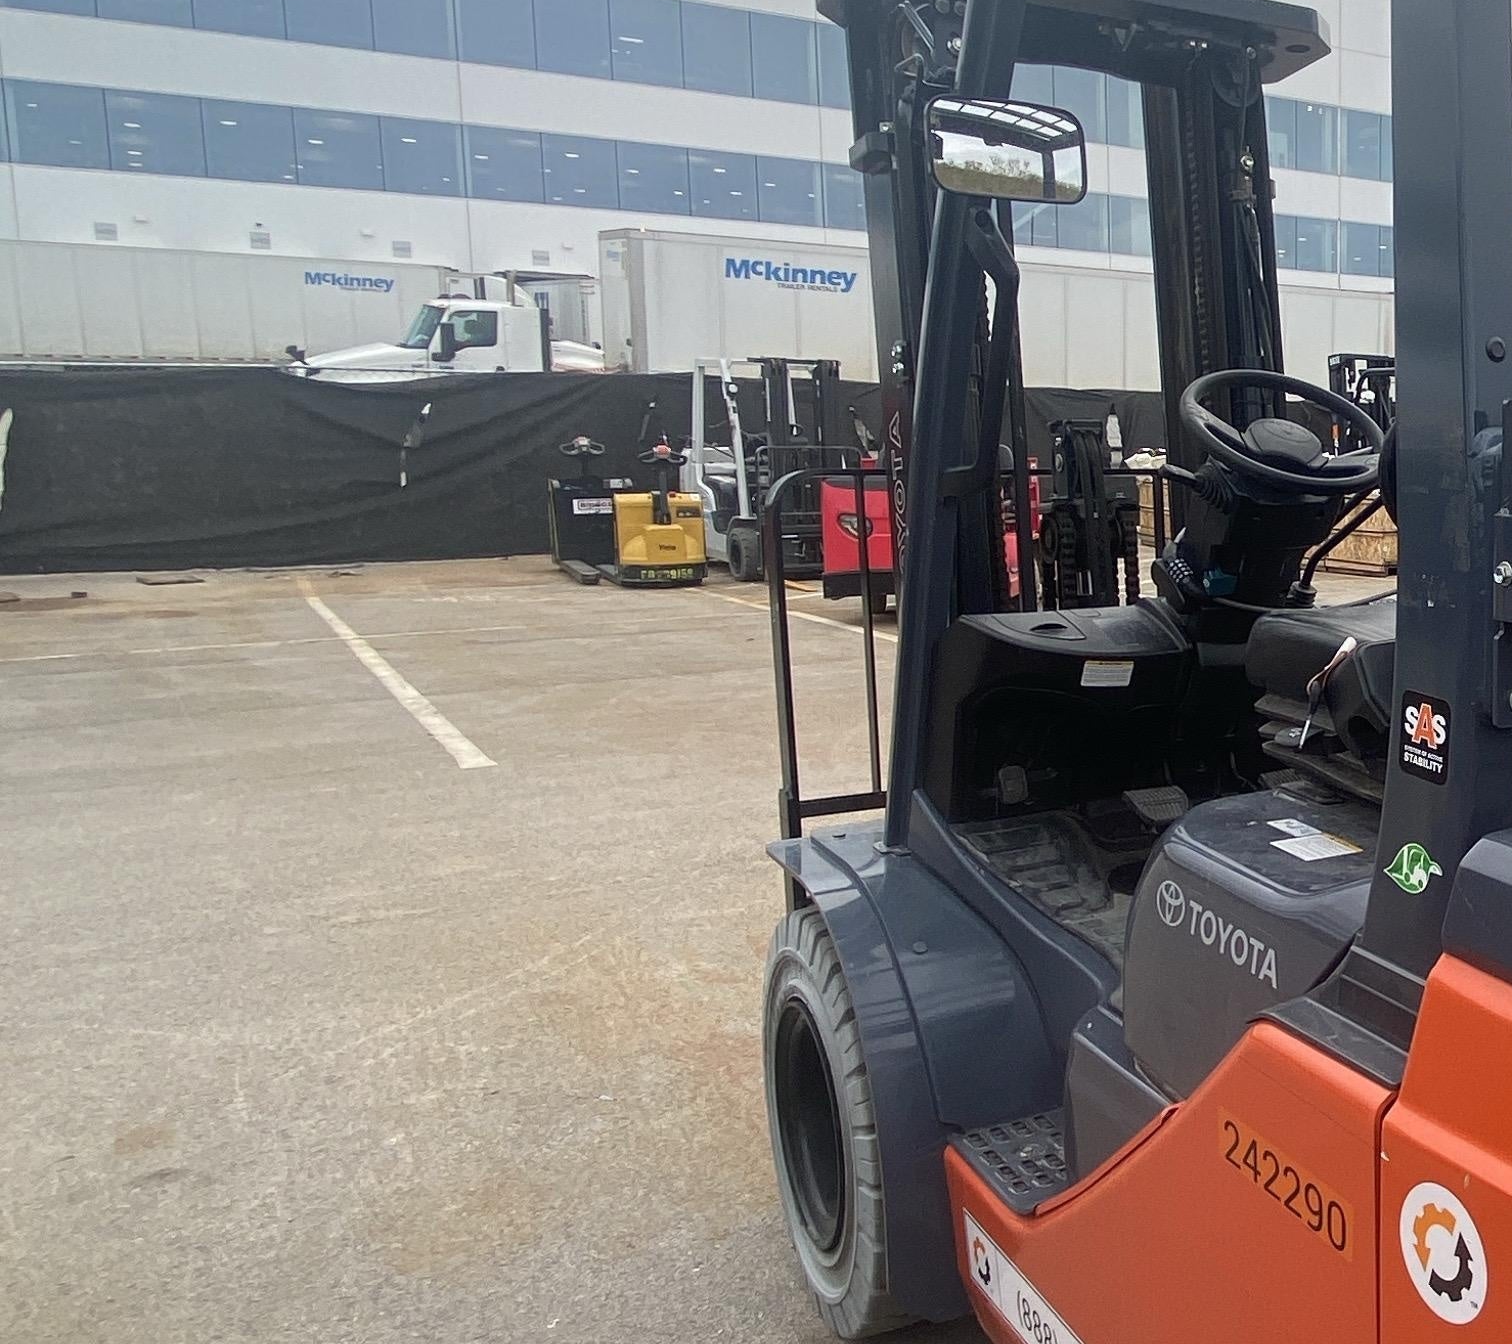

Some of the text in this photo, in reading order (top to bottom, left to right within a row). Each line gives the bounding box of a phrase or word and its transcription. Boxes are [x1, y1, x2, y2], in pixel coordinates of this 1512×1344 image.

[1404, 702, 1446, 750] SAS
[1404, 751, 1443, 774] STABILITY
[1189, 899, 1278, 990] TOYOTA
[1222, 1119, 1348, 1253] 242290
